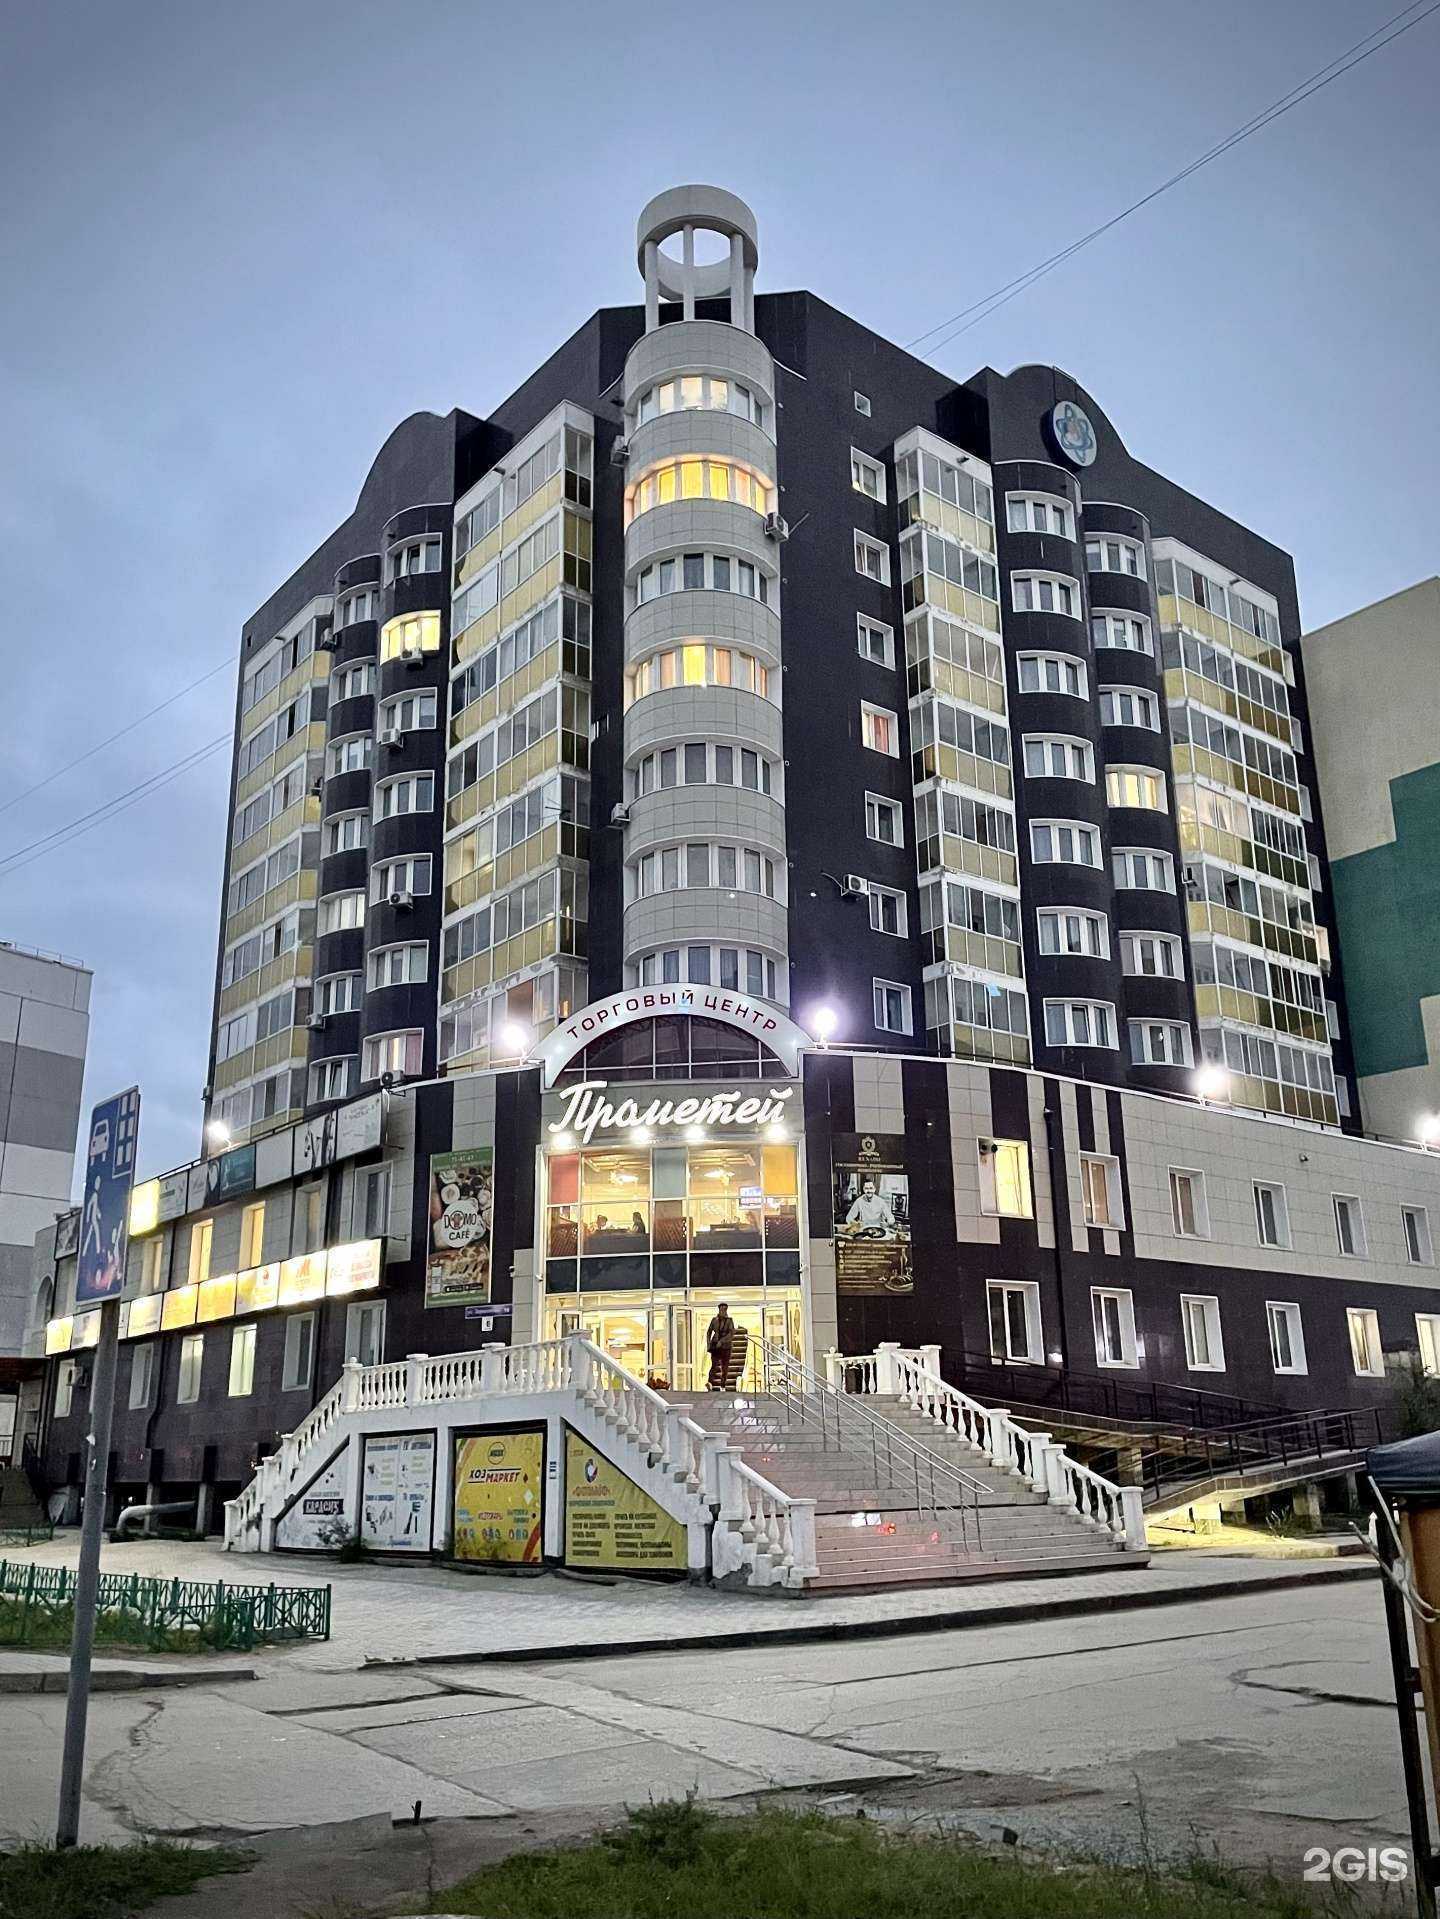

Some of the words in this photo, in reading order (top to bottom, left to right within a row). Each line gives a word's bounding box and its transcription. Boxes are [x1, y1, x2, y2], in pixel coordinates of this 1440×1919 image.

[567, 989, 694, 1039] ТОРГОВЫЙ
[704, 994, 779, 1033] ЦЕНТР
[548, 1080, 793, 1144] Прометей
[444, 1210, 477, 1231] DOMO
